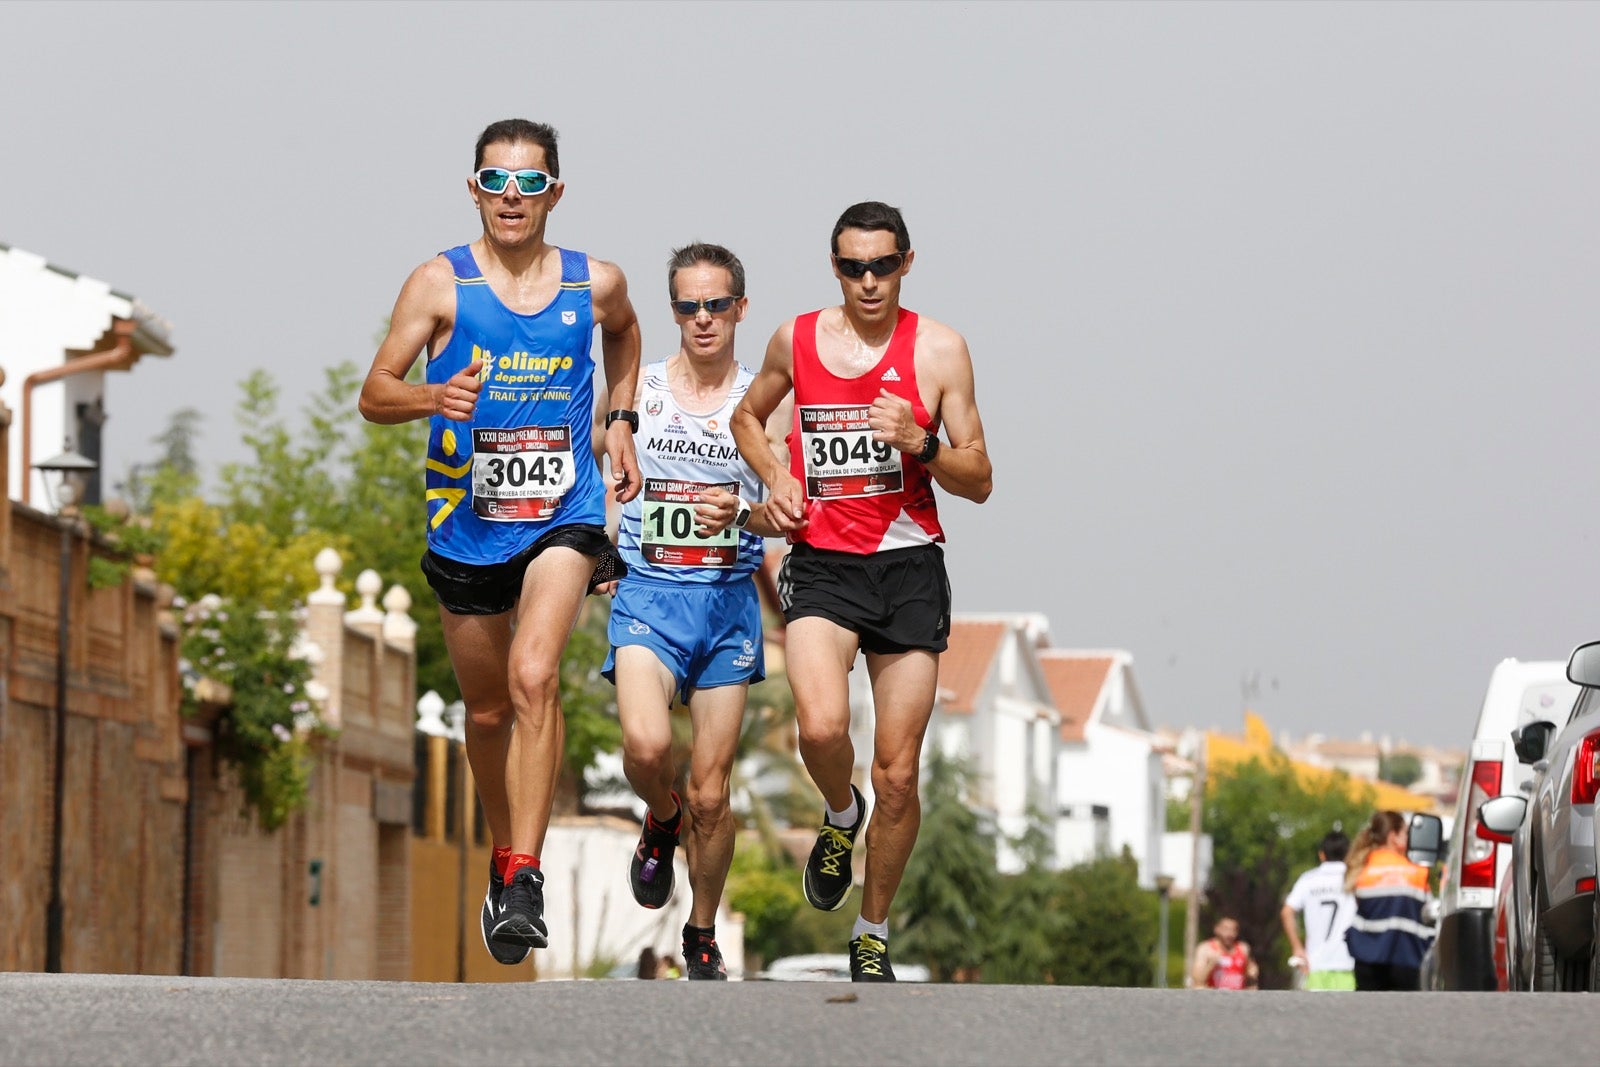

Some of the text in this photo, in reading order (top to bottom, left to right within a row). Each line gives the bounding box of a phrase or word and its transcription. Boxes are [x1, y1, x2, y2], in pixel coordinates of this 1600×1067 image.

[498, 351, 572, 375] olimpo
[494, 372, 546, 384] deportes
[489, 390, 517, 401] TRAIL
[520, 392, 528, 401] &
[817, 411, 834, 422] GRAN
[835, 410, 859, 421] PREMIO
[480, 432, 496, 442] XXXII
[498, 432, 515, 442] GRAN
[516, 430, 538, 441] PREMIO
[544, 430, 564, 440] FONDO
[647, 437, 739, 461] MARACENA
[812, 436, 892, 467] 3049
[689, 458, 728, 468] ATLETISMO
[486, 456, 564, 488] 3043
[667, 482, 682, 492] GRAN
[1321, 900, 1338, 942] 7
